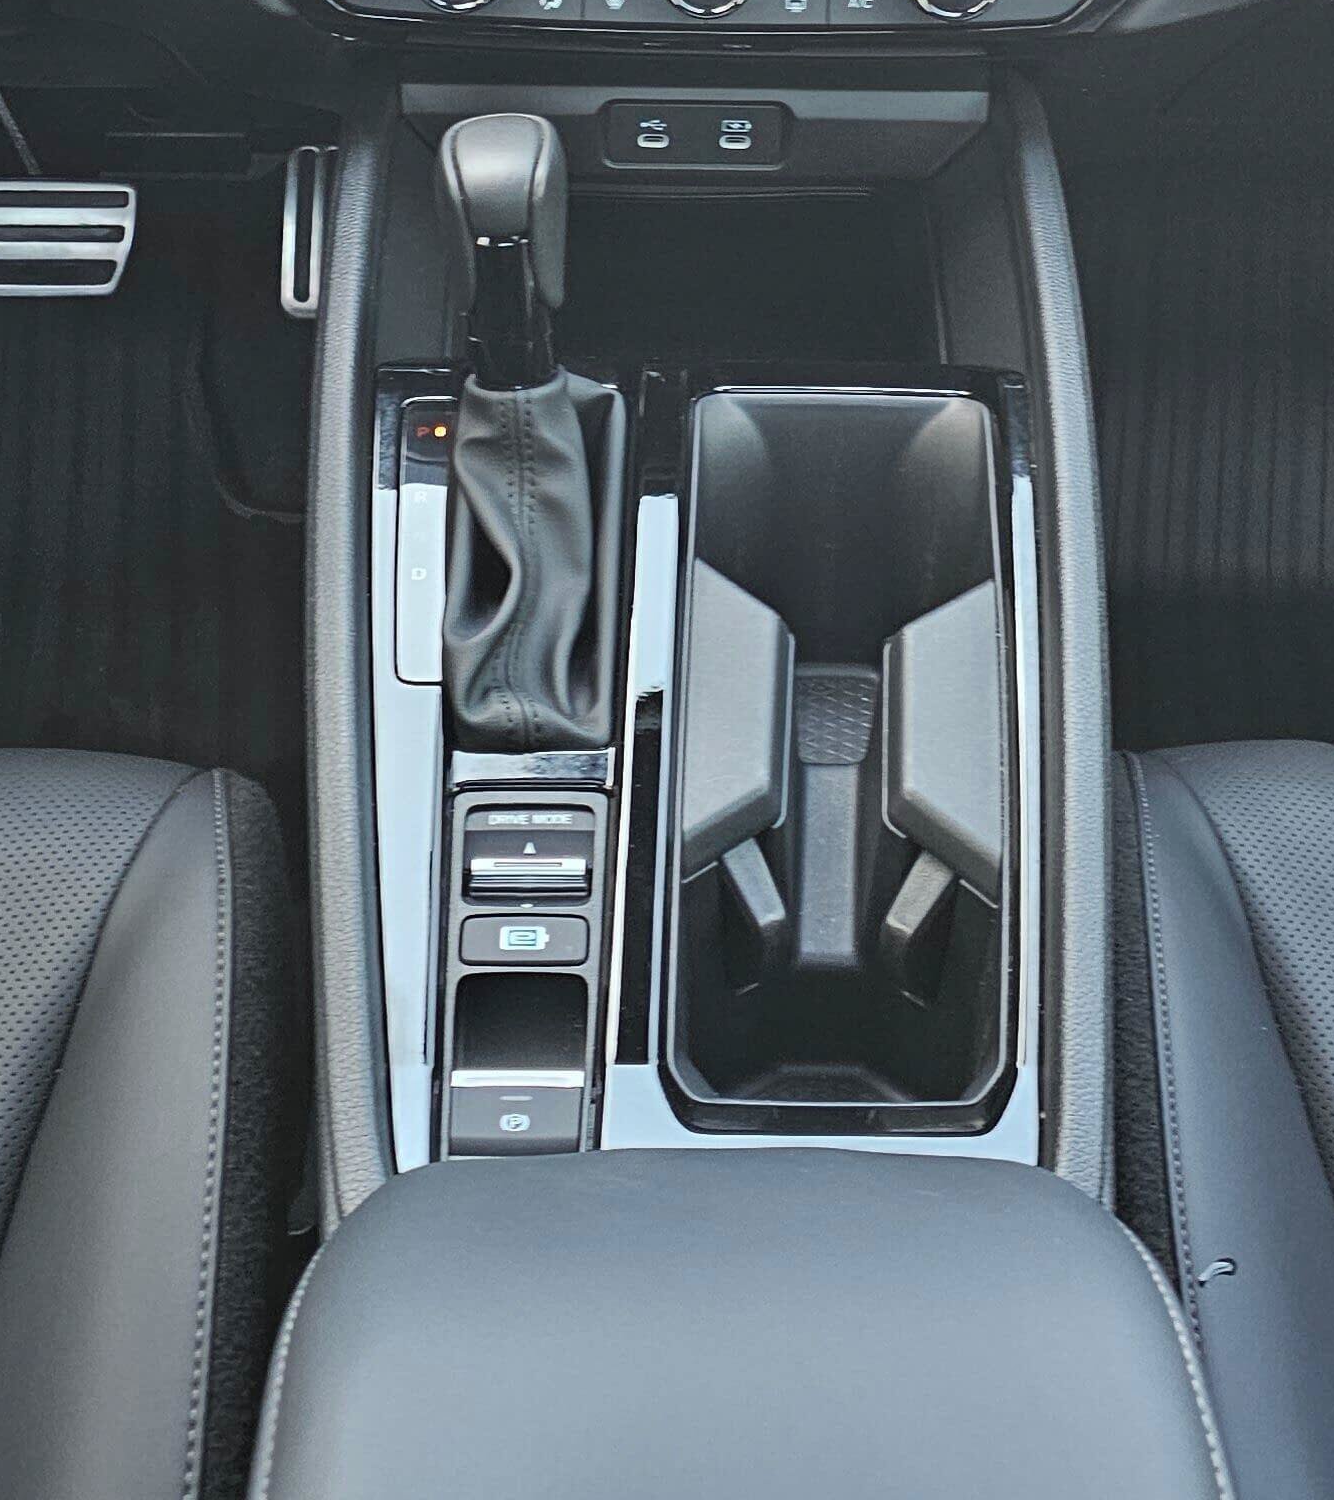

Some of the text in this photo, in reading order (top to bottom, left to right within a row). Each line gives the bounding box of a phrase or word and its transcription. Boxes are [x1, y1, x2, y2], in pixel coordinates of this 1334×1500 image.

[411, 568, 427, 580] D
[488, 813, 573, 826] DRIVE MODE
